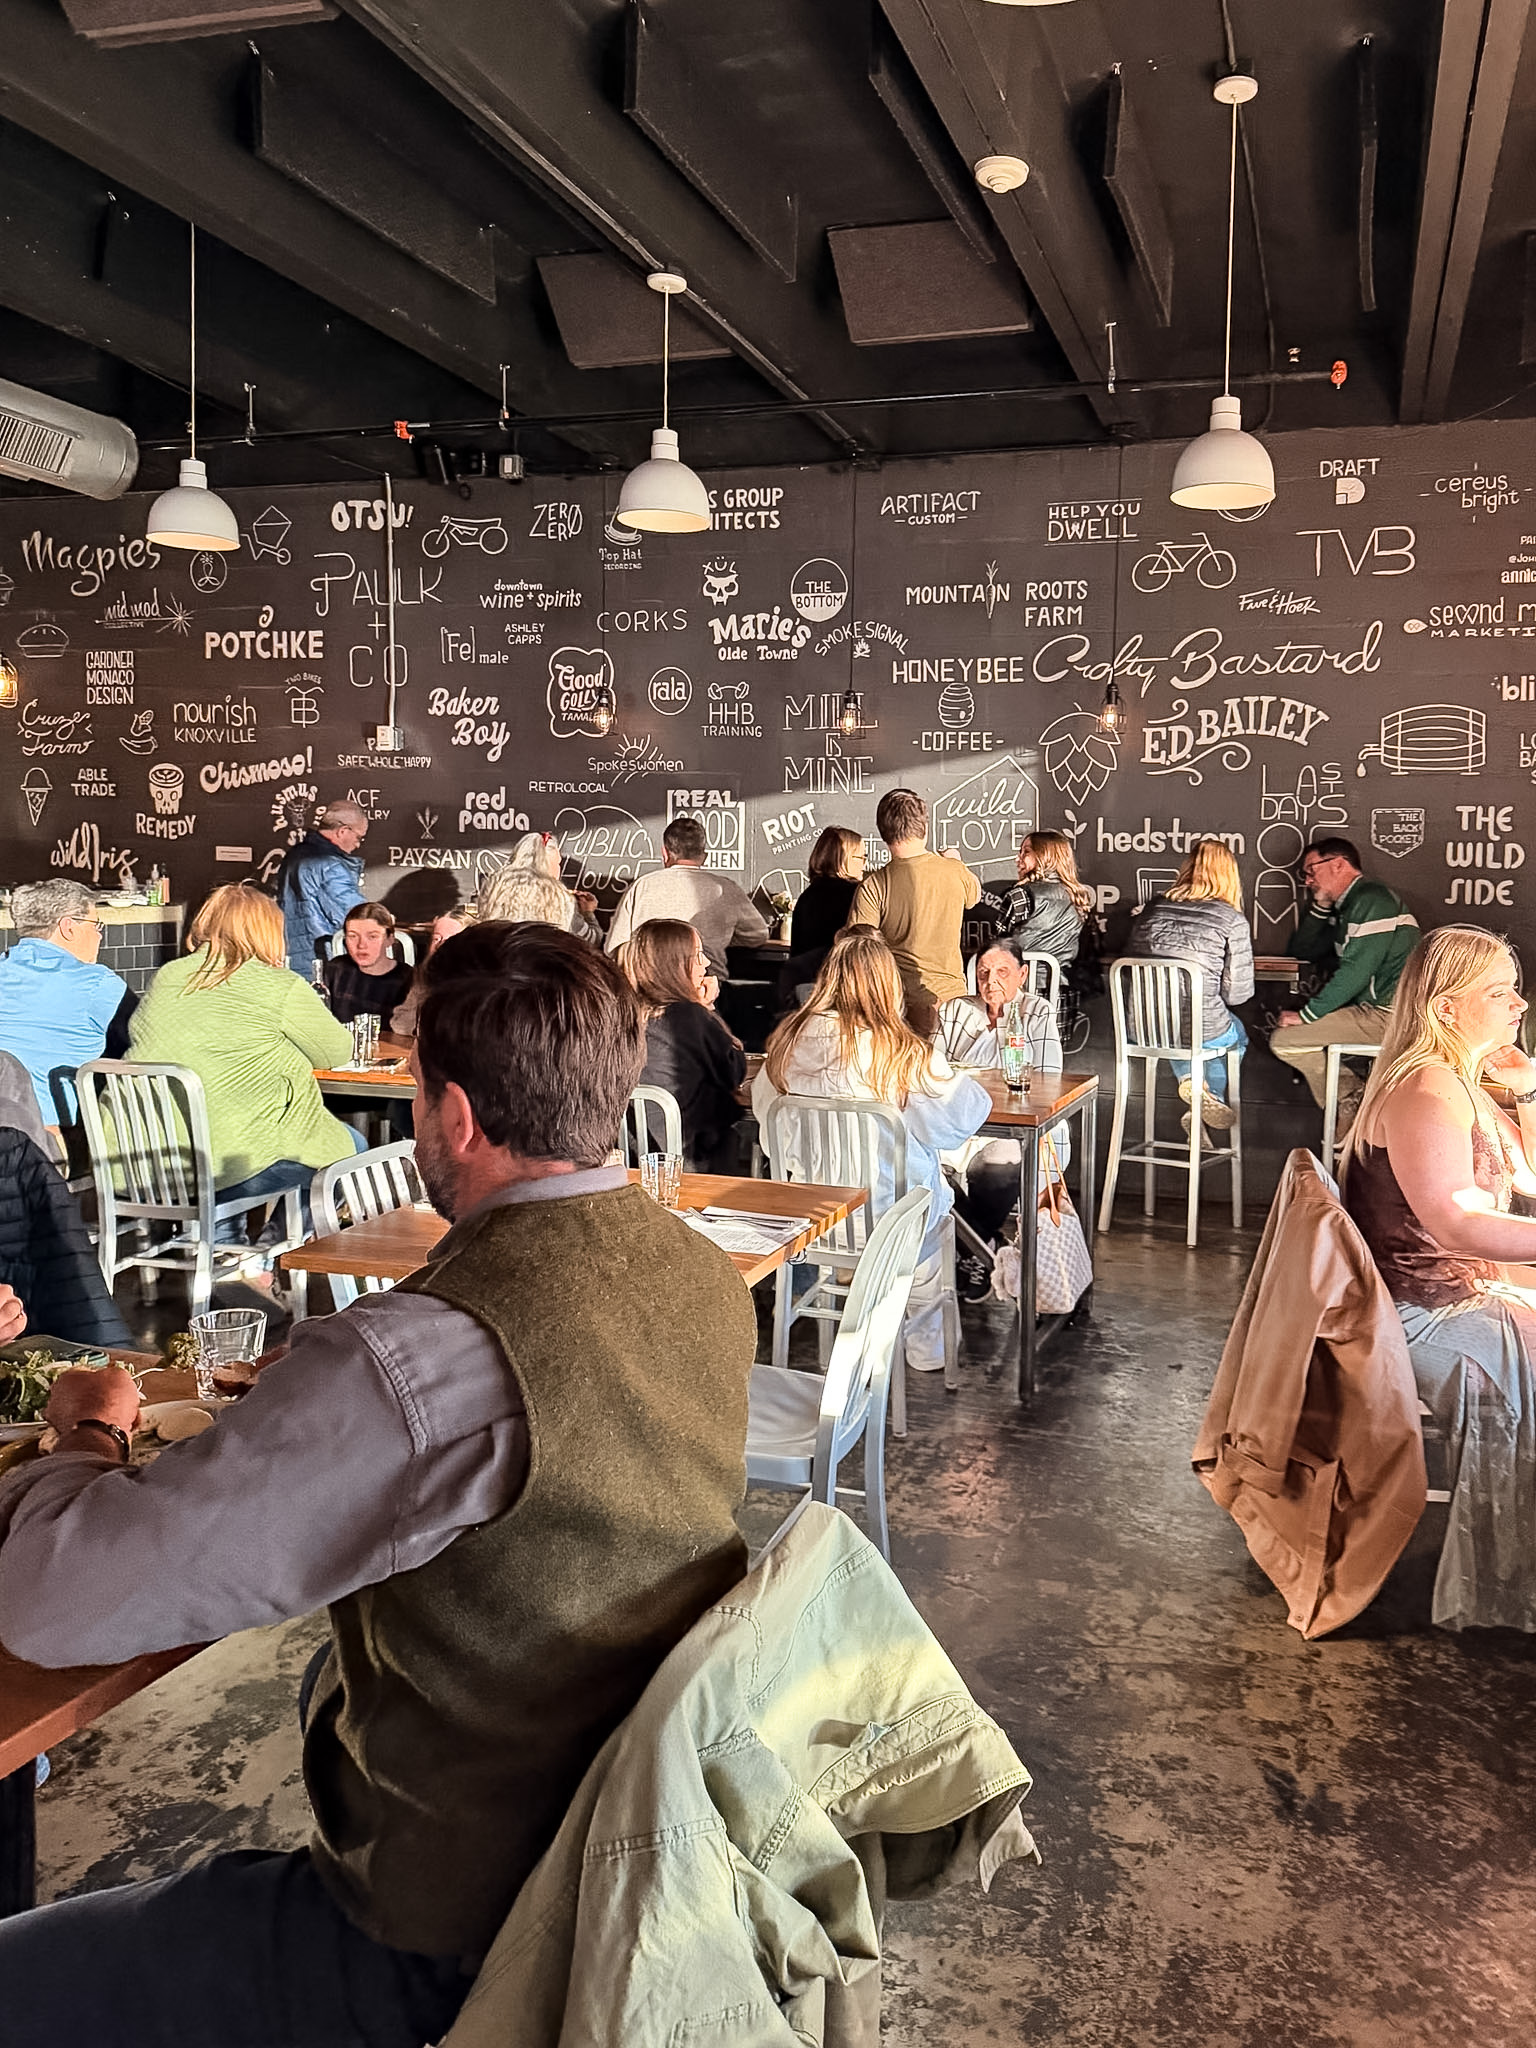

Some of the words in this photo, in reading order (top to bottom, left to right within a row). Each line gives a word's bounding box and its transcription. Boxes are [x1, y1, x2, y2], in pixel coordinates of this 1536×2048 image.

[1319, 458, 1381, 479] DRAFT
[1434, 474, 1509, 493] cereus
[723, 487, 784, 508] GROUP
[880, 491, 982, 515] ARTIFACT
[1461, 489, 1520, 513] bright
[331, 499, 414, 532] OTSU!
[708, 510, 781, 531] ITECTS
[907, 514, 956, 526] CUSTOM
[1048, 505, 1090, 520] HELP
[1095, 503, 1142, 517] YOU
[1048, 518, 1138, 542] DWELL
[599, 548, 619, 563] Top
[622, 548, 642, 560] Hat
[1295, 525, 1416, 577] TVB
[21, 531, 161, 597] Magpies
[494, 579, 543, 591] downtown
[805, 581, 832, 593] THE
[1025, 580, 1089, 601] ROOTS
[104, 591, 129, 620] mid
[130, 587, 162, 618] mod
[479, 592, 524, 609] wine
[536, 588, 582, 611] spirits
[796, 595, 843, 609] BOTTOM
[504, 623, 545, 633] ASHLEY
[597, 609, 688, 633] CORKS
[708, 606, 812, 648] Marie's
[1024, 605, 1084, 628] FARM
[204, 631, 324, 660] POTCHKE
[507, 634, 542, 645] CAPPS
[815, 621, 862, 656] SMOKE
[865, 621, 909, 655] SIGNAL
[86, 651, 134, 669] GARDNER
[479, 651, 509, 664] male
[718, 647, 748, 661] Olde
[757, 646, 798, 661] Towne
[1033, 634, 1169, 699] Crafty
[1170, 620, 1384, 690] Bastard
[86, 670, 134, 686] MONACO
[555, 664, 604, 691] Good
[652, 676, 687, 701] rala
[86, 687, 134, 705] DESIGN
[428, 687, 500, 717] Baker
[560, 689, 599, 712] GOLLY
[173, 695, 257, 727] nourish
[708, 702, 755, 725] HHB
[1195, 695, 1331, 747] BAILEY
[173, 727, 257, 744] KNOXVILLE
[451, 717, 511, 763] Boy
[702, 725, 763, 738] TRAINING
[77, 768, 108, 781] ABLE
[200, 745, 313, 793] Chismoso!
[588, 757, 684, 774] Spokeswomen
[782, 756, 875, 796] MINE
[71, 783, 117, 797] TRADE
[465, 786, 506, 811] red
[529, 781, 609, 793] RETROLOCAL
[947, 777, 1024, 817] wild
[674, 790, 739, 808] REAL
[136, 813, 197, 841] REMEDY
[459, 808, 530, 833] panda
[761, 802, 817, 845] RIOT
[1392, 823, 1420, 833] BACK
[1398, 813, 1420, 822] THE
[1455, 805, 1515, 841] THE
[772, 833, 812, 855] PRINTING
[938, 819, 1033, 851] LOVE
[388, 846, 472, 870] PAYSAN
[1445, 841, 1526, 870] WILD
[1444, 878, 1515, 906] SIDE
